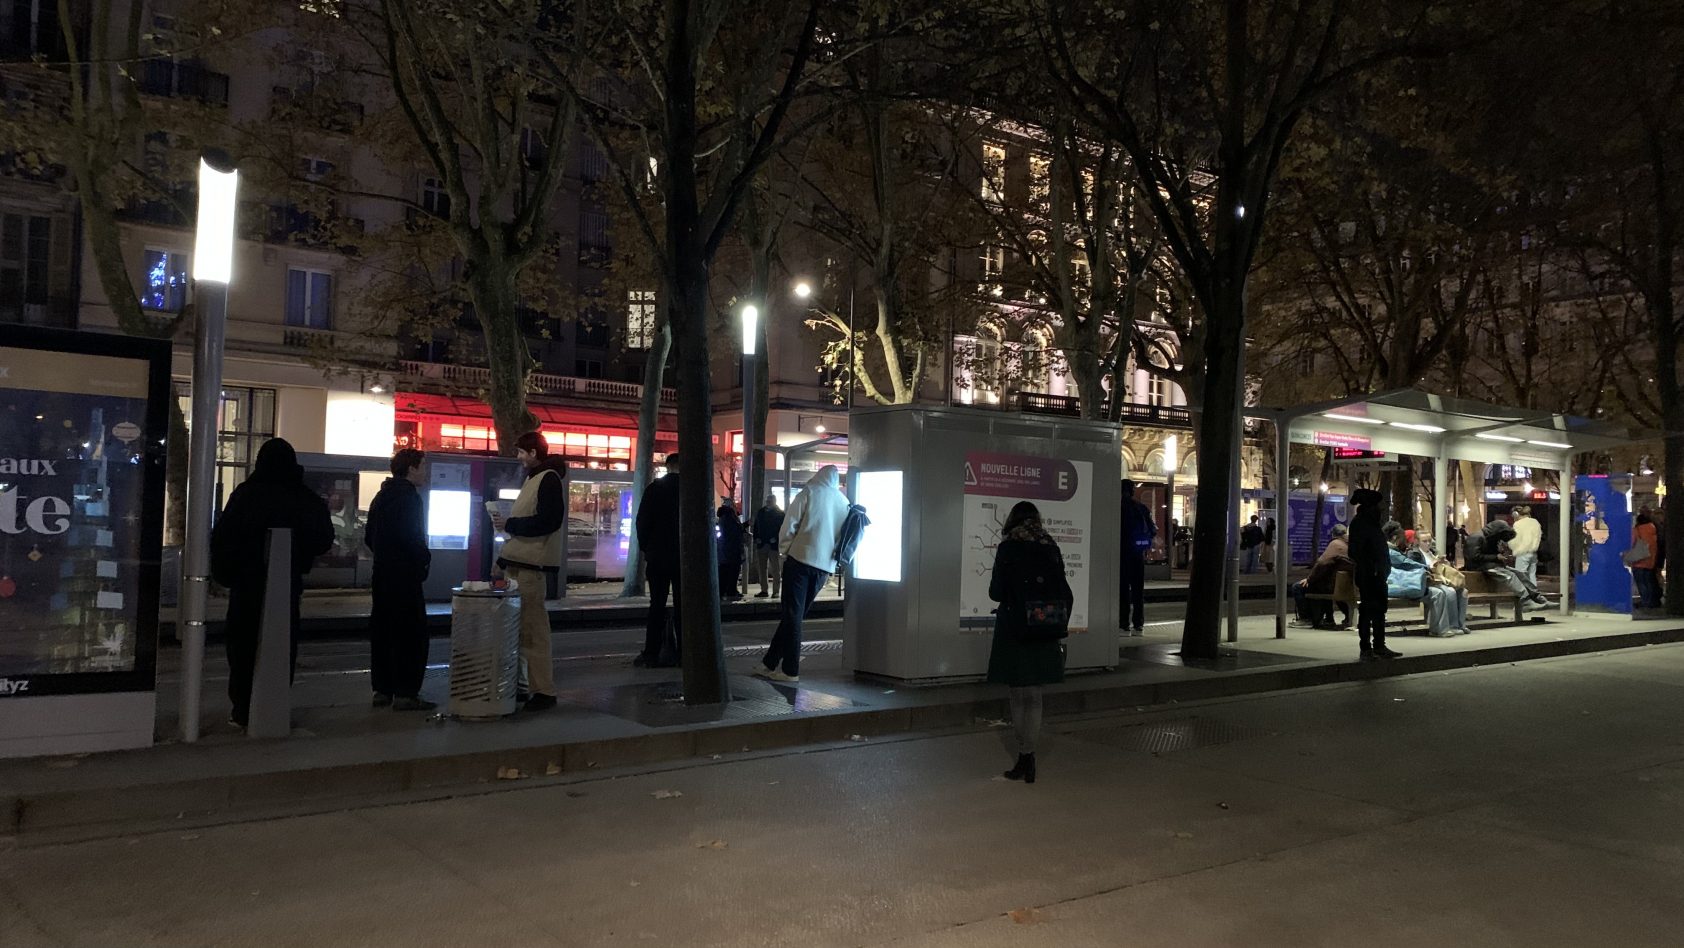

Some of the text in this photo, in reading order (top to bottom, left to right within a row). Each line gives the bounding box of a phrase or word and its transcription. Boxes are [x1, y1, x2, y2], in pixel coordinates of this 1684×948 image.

[981, 463, 1041, 478] NOUVELLE LIGNE
[1058, 472, 1068, 489] E
